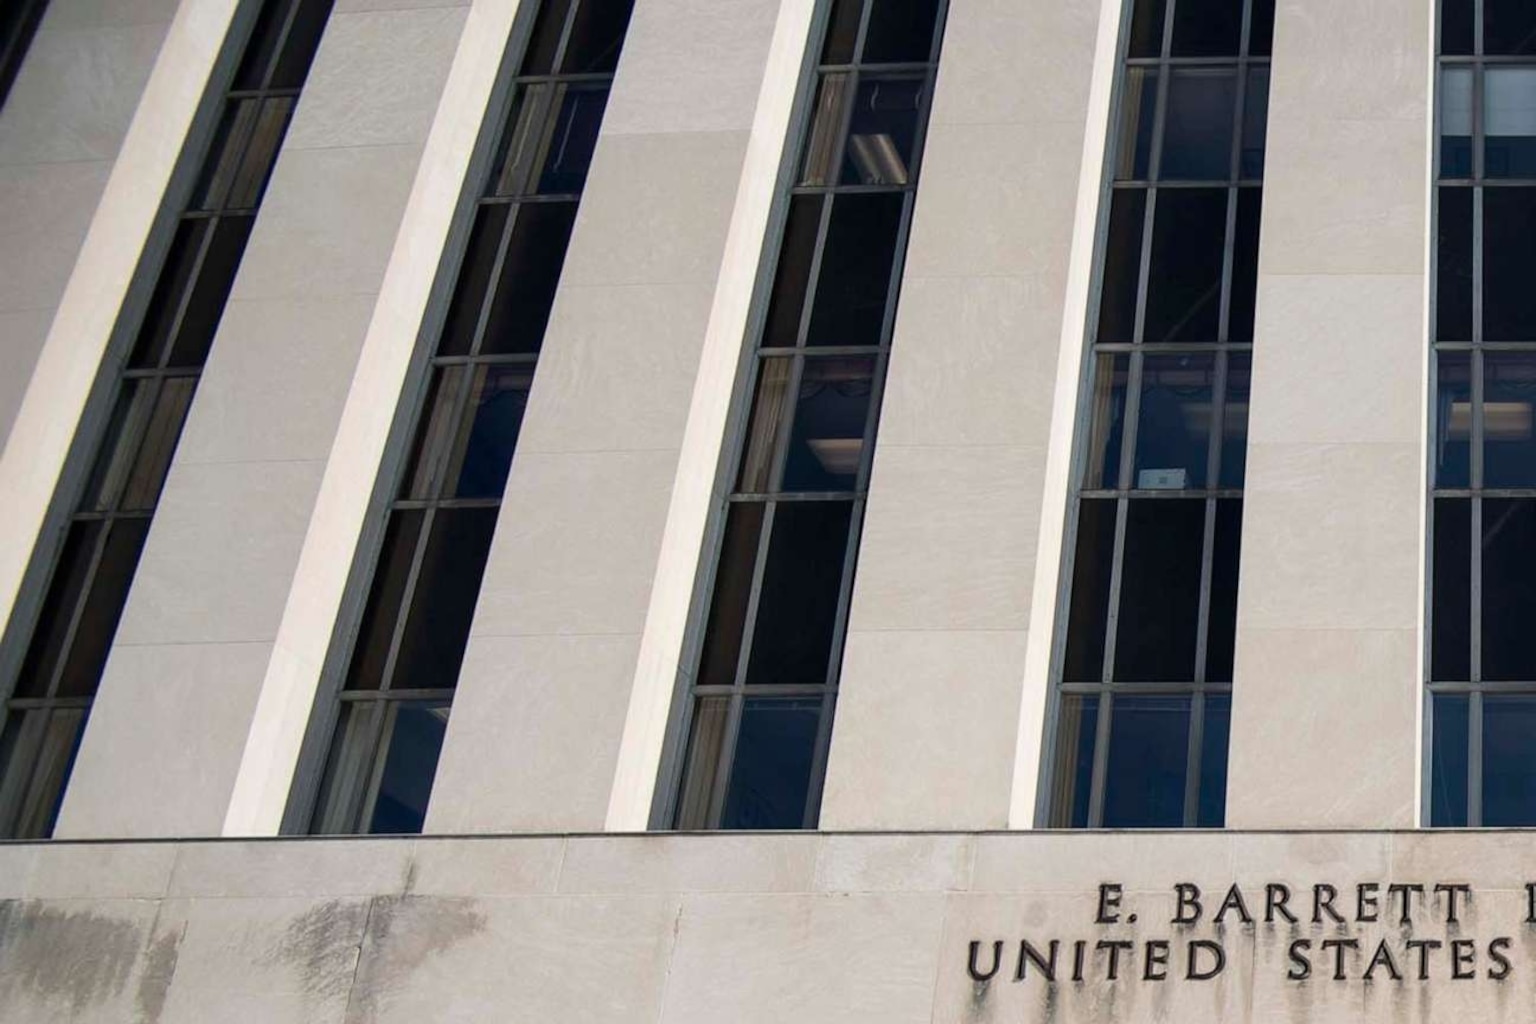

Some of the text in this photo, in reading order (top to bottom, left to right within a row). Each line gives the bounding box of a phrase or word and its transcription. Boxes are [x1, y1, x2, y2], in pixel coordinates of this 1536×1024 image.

[1094, 883, 1138, 924] E.
[1171, 882, 1473, 924] BARRETT
[966, 939, 1227, 982] UNITED
[1286, 937, 1514, 981] STATES
